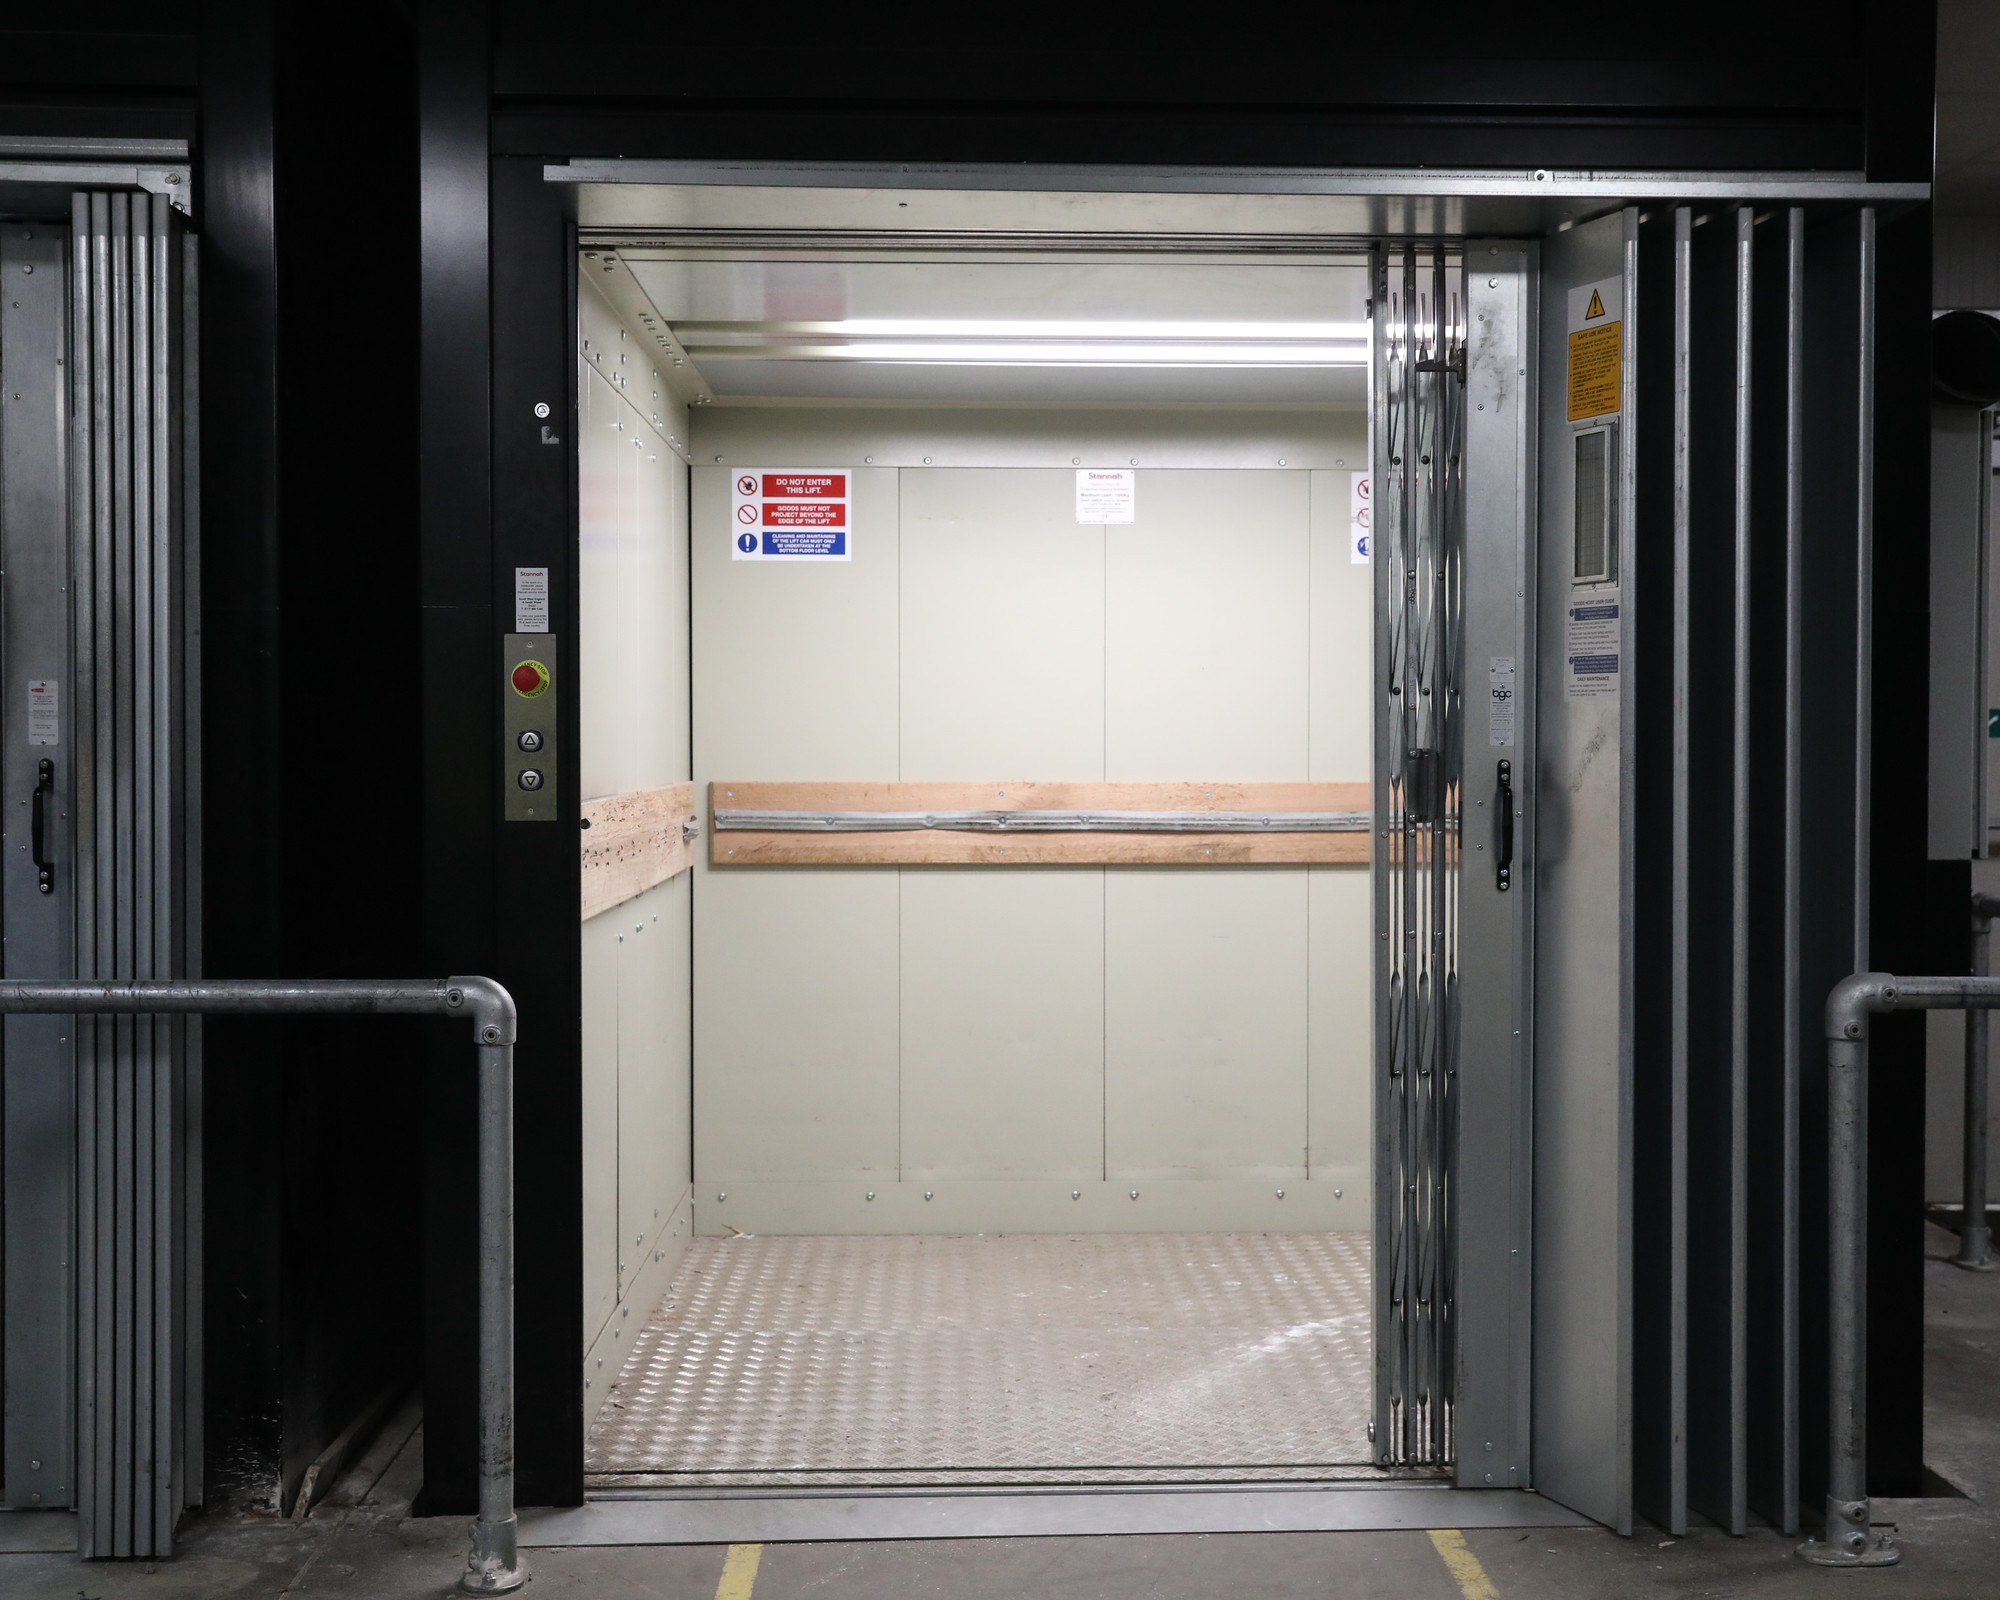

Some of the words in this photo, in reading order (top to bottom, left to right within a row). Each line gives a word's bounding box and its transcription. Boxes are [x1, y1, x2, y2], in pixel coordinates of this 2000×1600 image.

[1598, 327, 1612, 335] NOTICE
[1088, 472, 1122, 480] Stannah
[806, 478, 832, 486] ENTER
[786, 486, 803, 494] THIS
[804, 486, 822, 494] LIFT.
[1492, 689, 1512, 701] bgc
